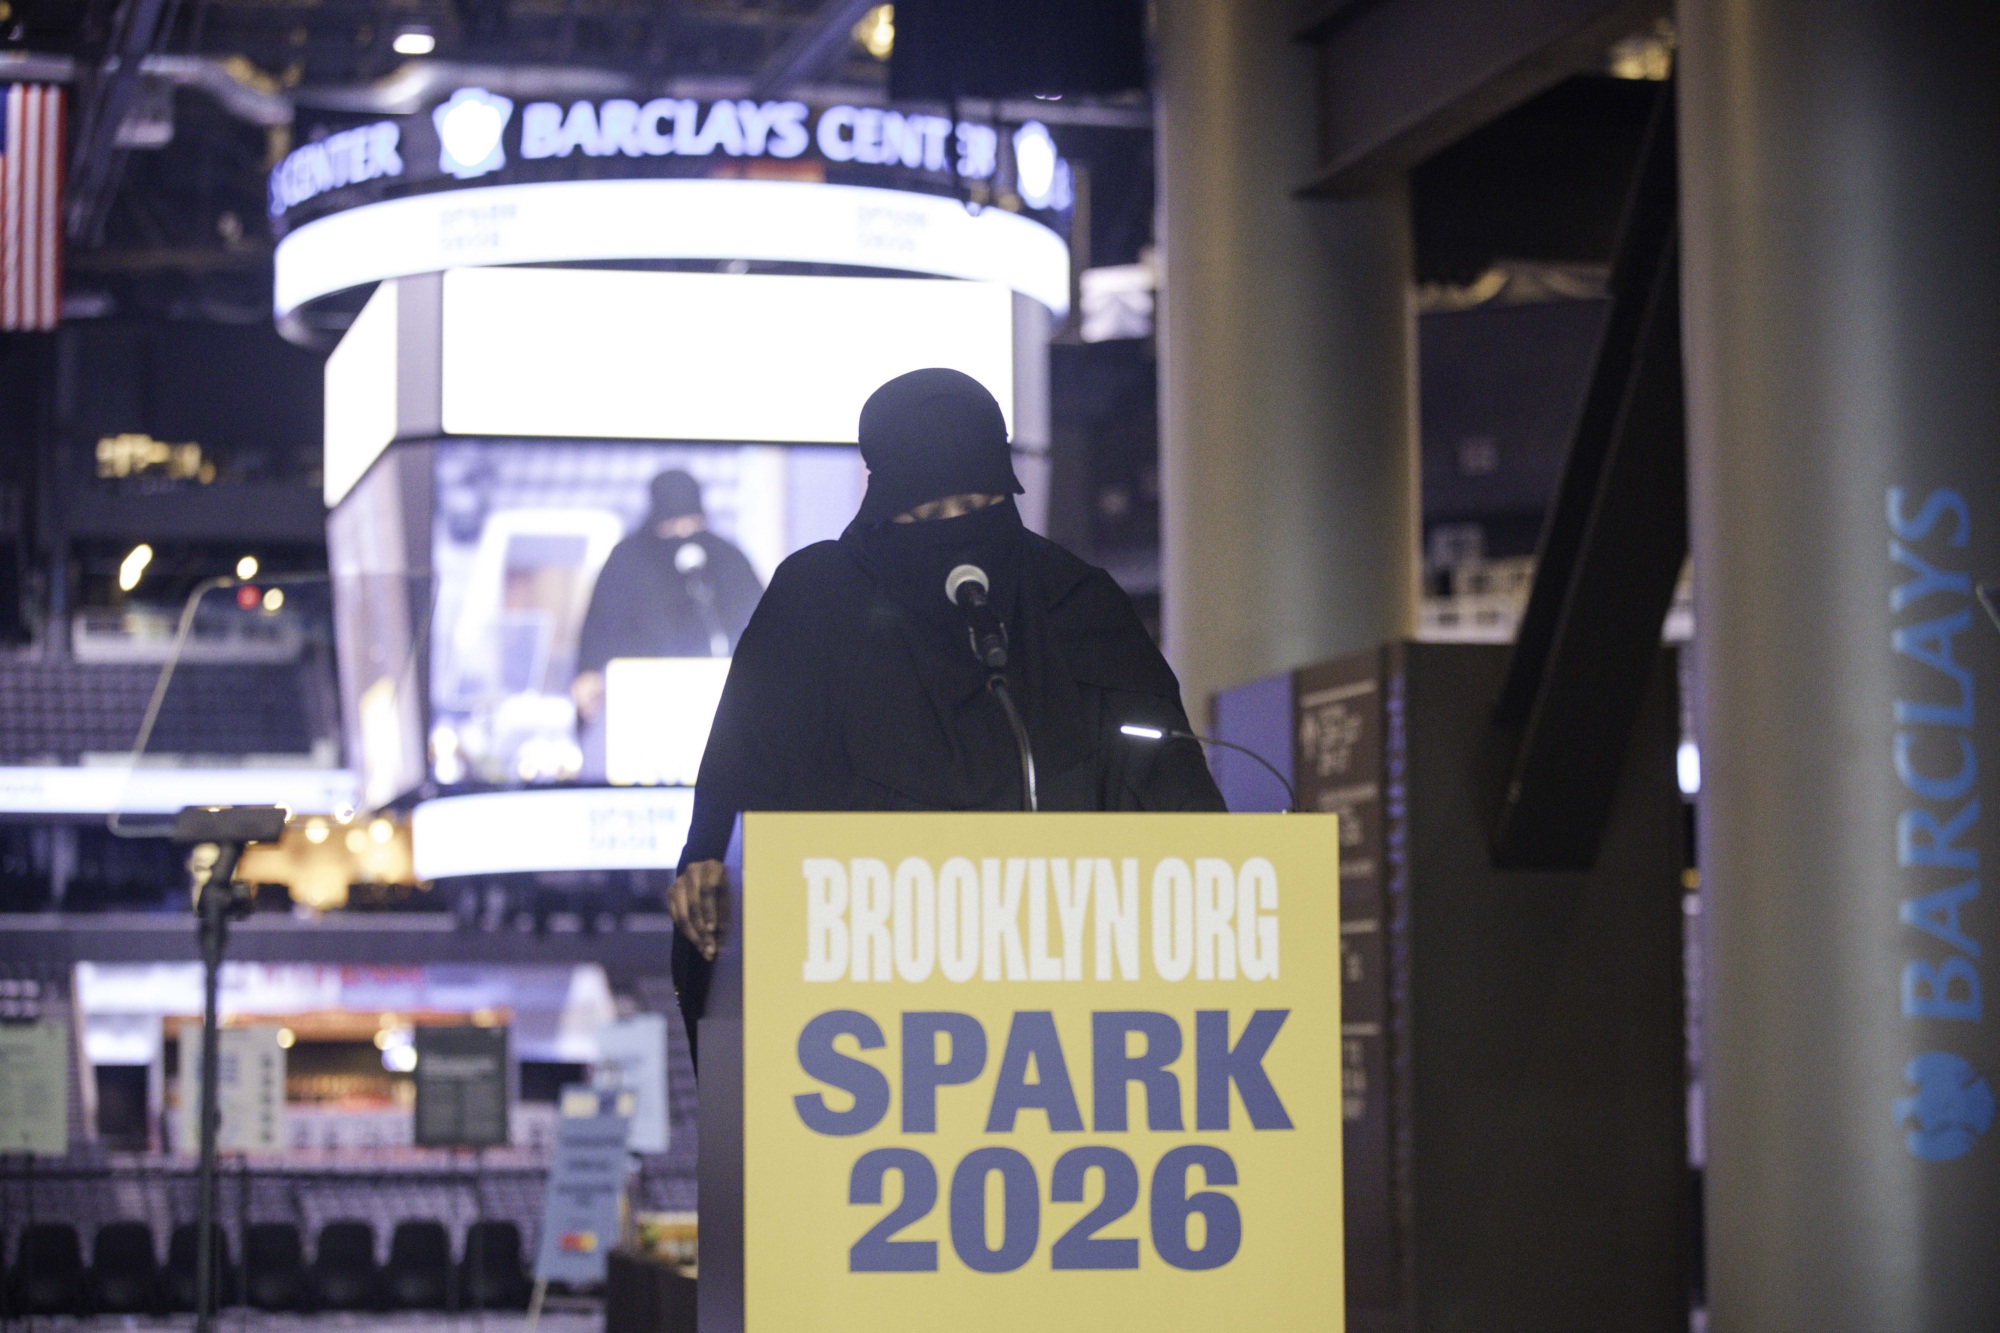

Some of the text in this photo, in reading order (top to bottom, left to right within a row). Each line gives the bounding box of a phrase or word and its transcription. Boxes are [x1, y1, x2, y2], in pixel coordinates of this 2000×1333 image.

[520, 99, 810, 159] BARCLAYS
[1887, 486, 1983, 1023] BARCLAYS
[802, 856, 1280, 983] BROOKLYN ORG
[792, 1007, 1296, 1137] SPARK
[847, 1144, 1243, 1274] 2026
